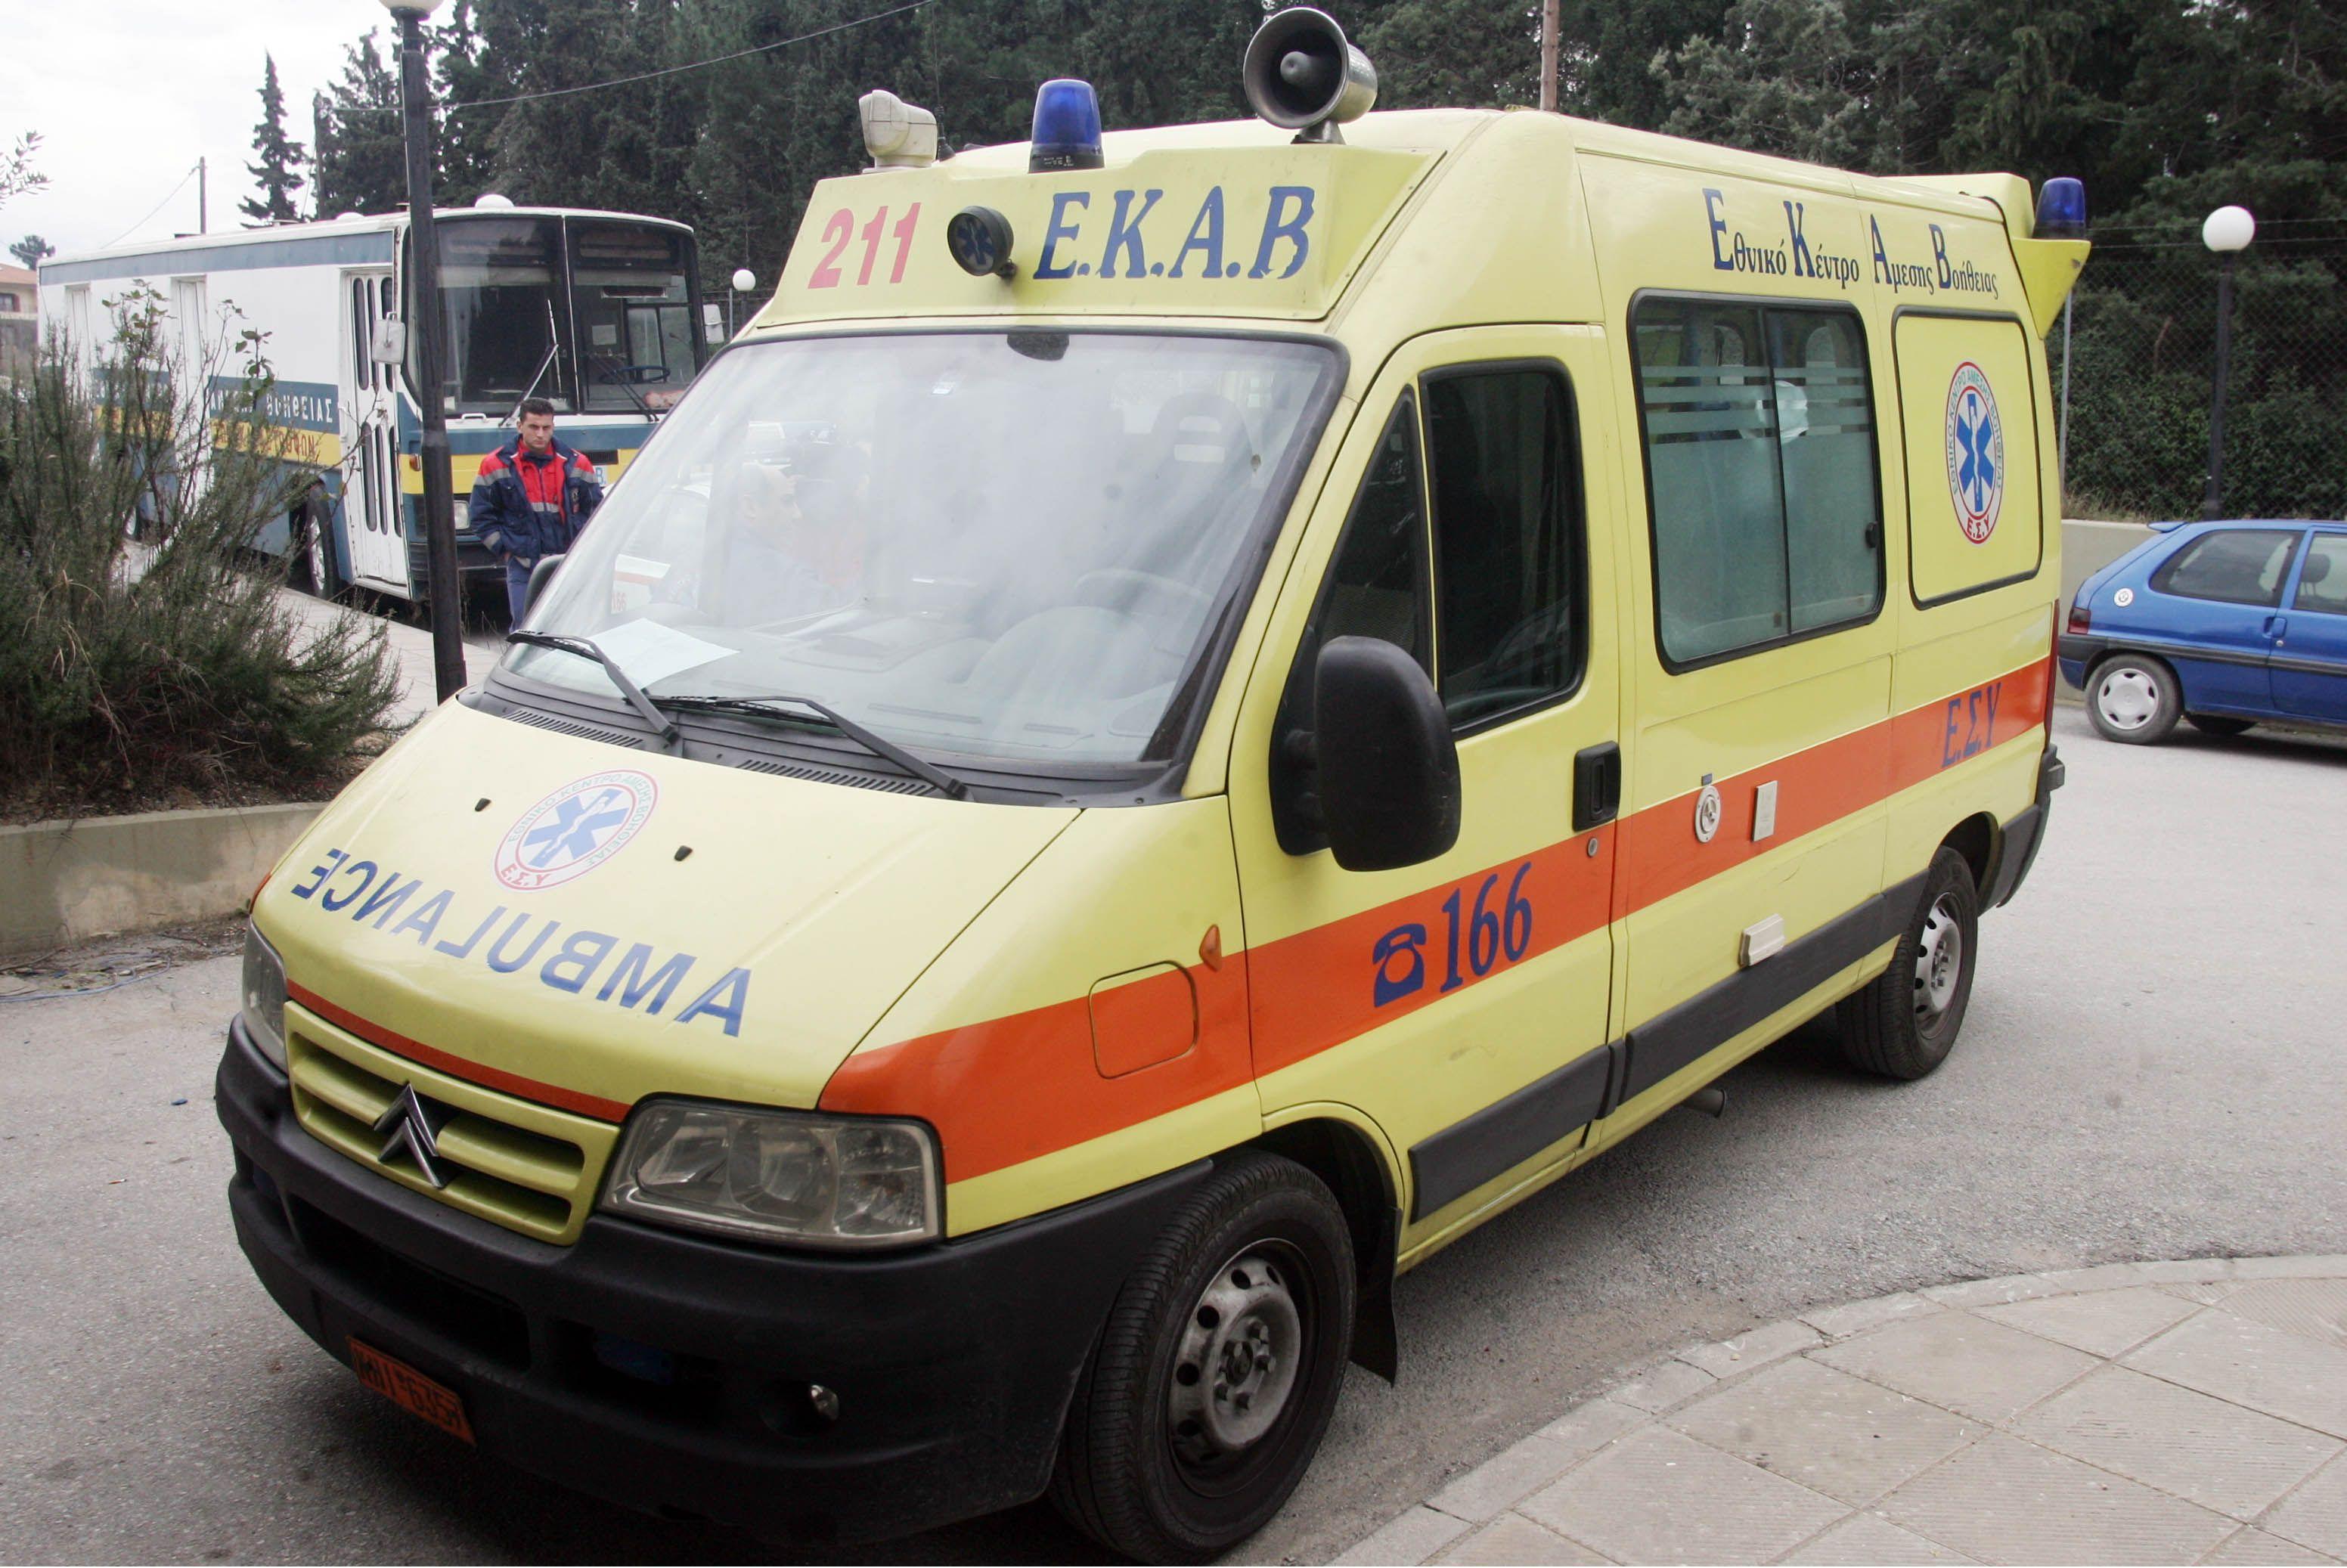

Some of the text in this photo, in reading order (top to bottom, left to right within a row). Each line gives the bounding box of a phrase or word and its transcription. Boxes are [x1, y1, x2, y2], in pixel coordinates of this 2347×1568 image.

[808, 202, 921, 289] 211
[1702, 188, 1999, 300] Εθνικό Κέντρο Αμεσης Βοήθειας
[1440, 861, 1532, 993] 166
